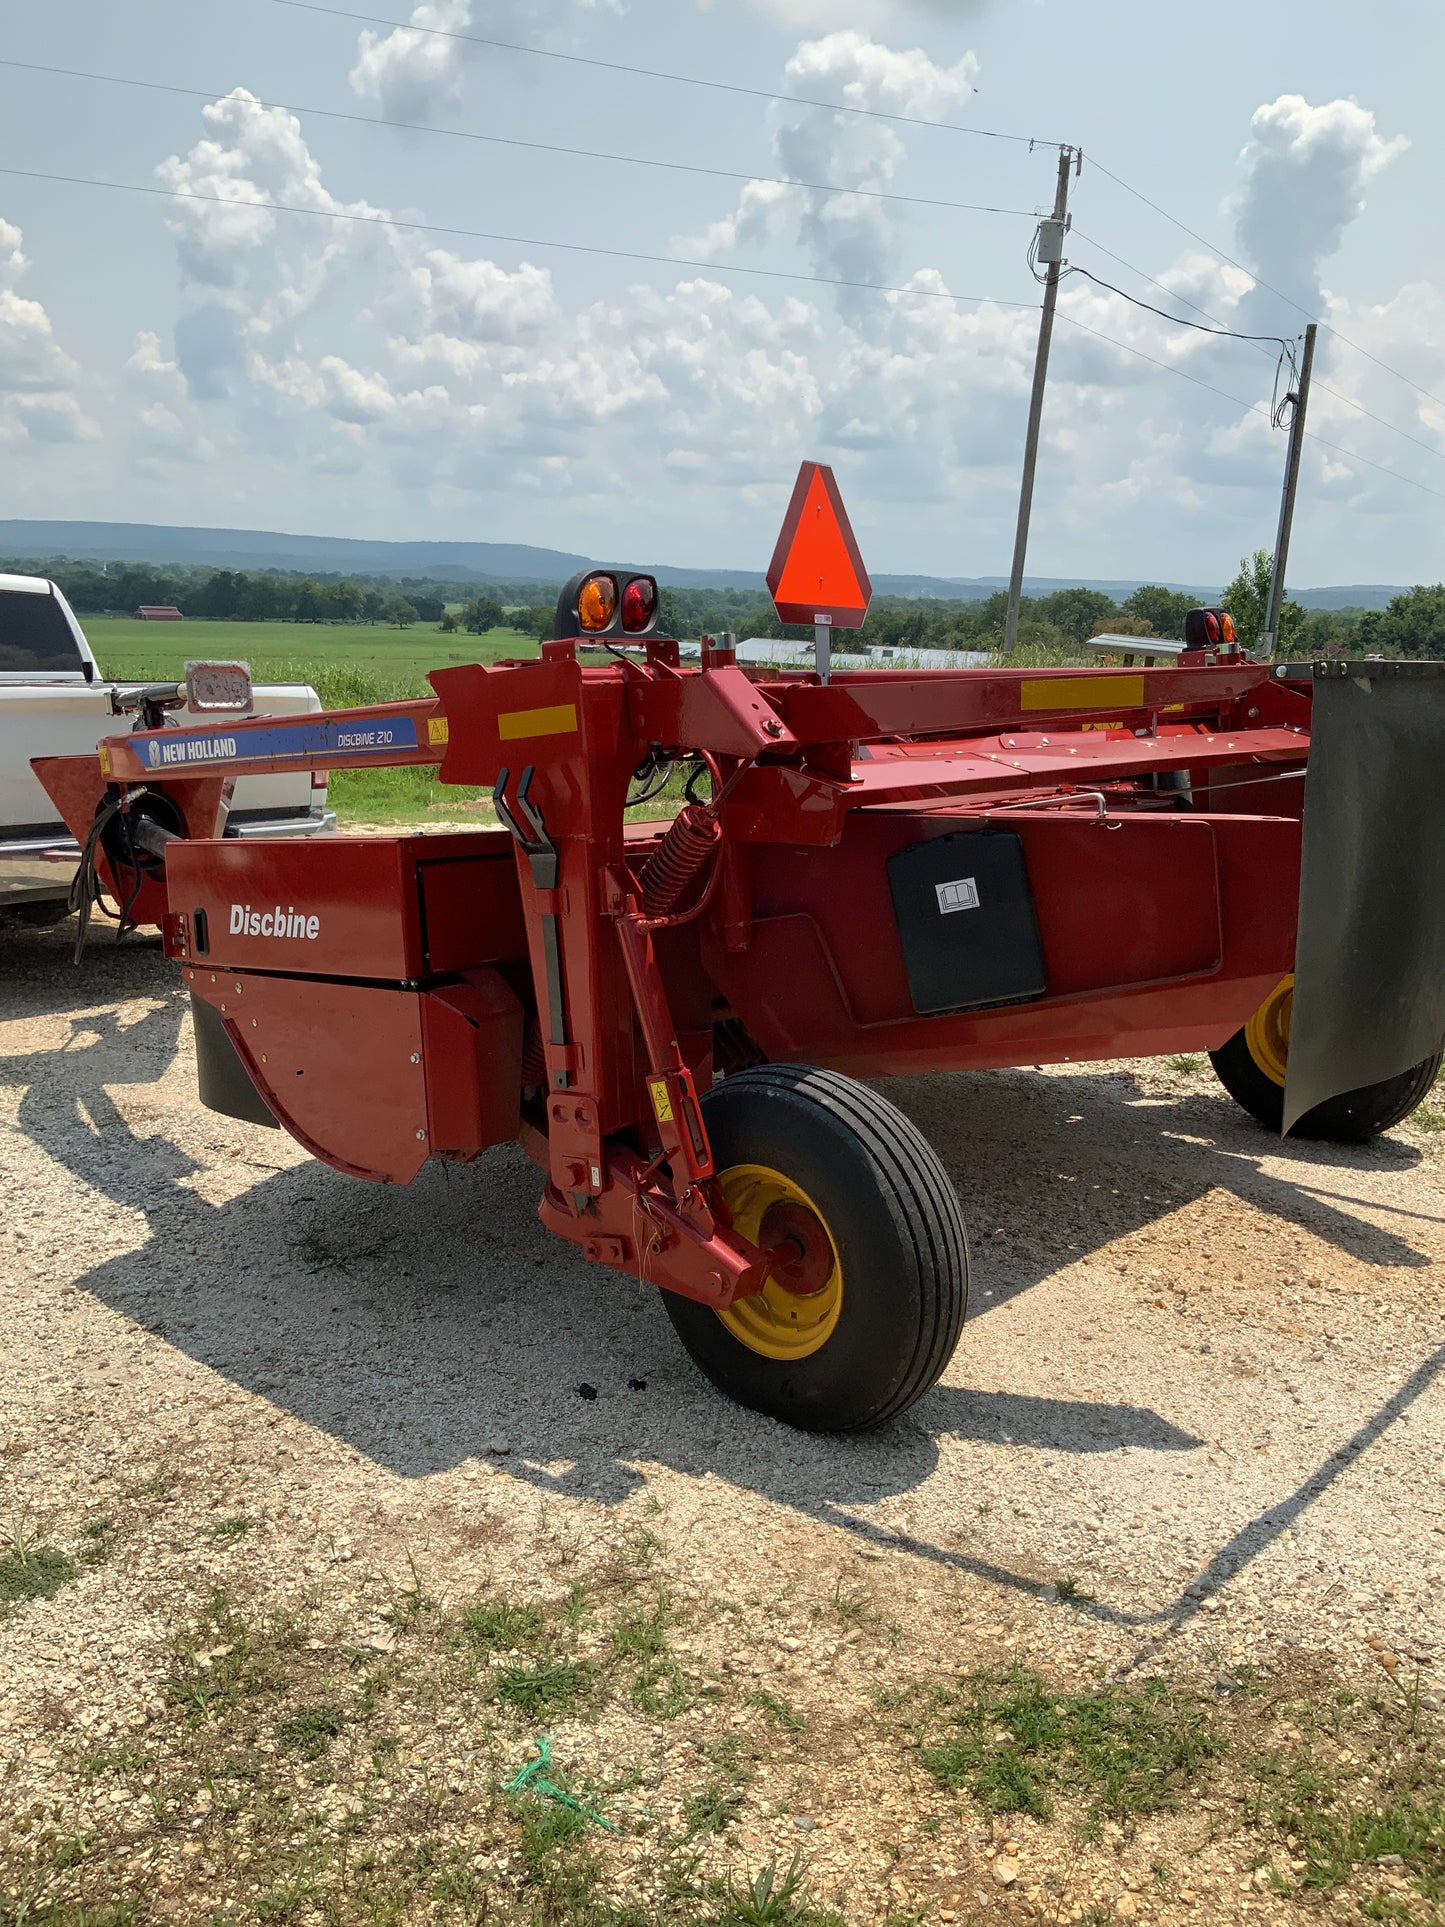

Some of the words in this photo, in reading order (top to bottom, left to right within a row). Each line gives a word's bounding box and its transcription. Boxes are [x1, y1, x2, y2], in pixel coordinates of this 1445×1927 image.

[162, 742, 186, 763] NEW
[187, 738, 237, 760] HOLLAND
[337, 732, 375, 747] DISCBINE
[376, 730, 393, 744] 210
[229, 904, 320, 940] Discbine
